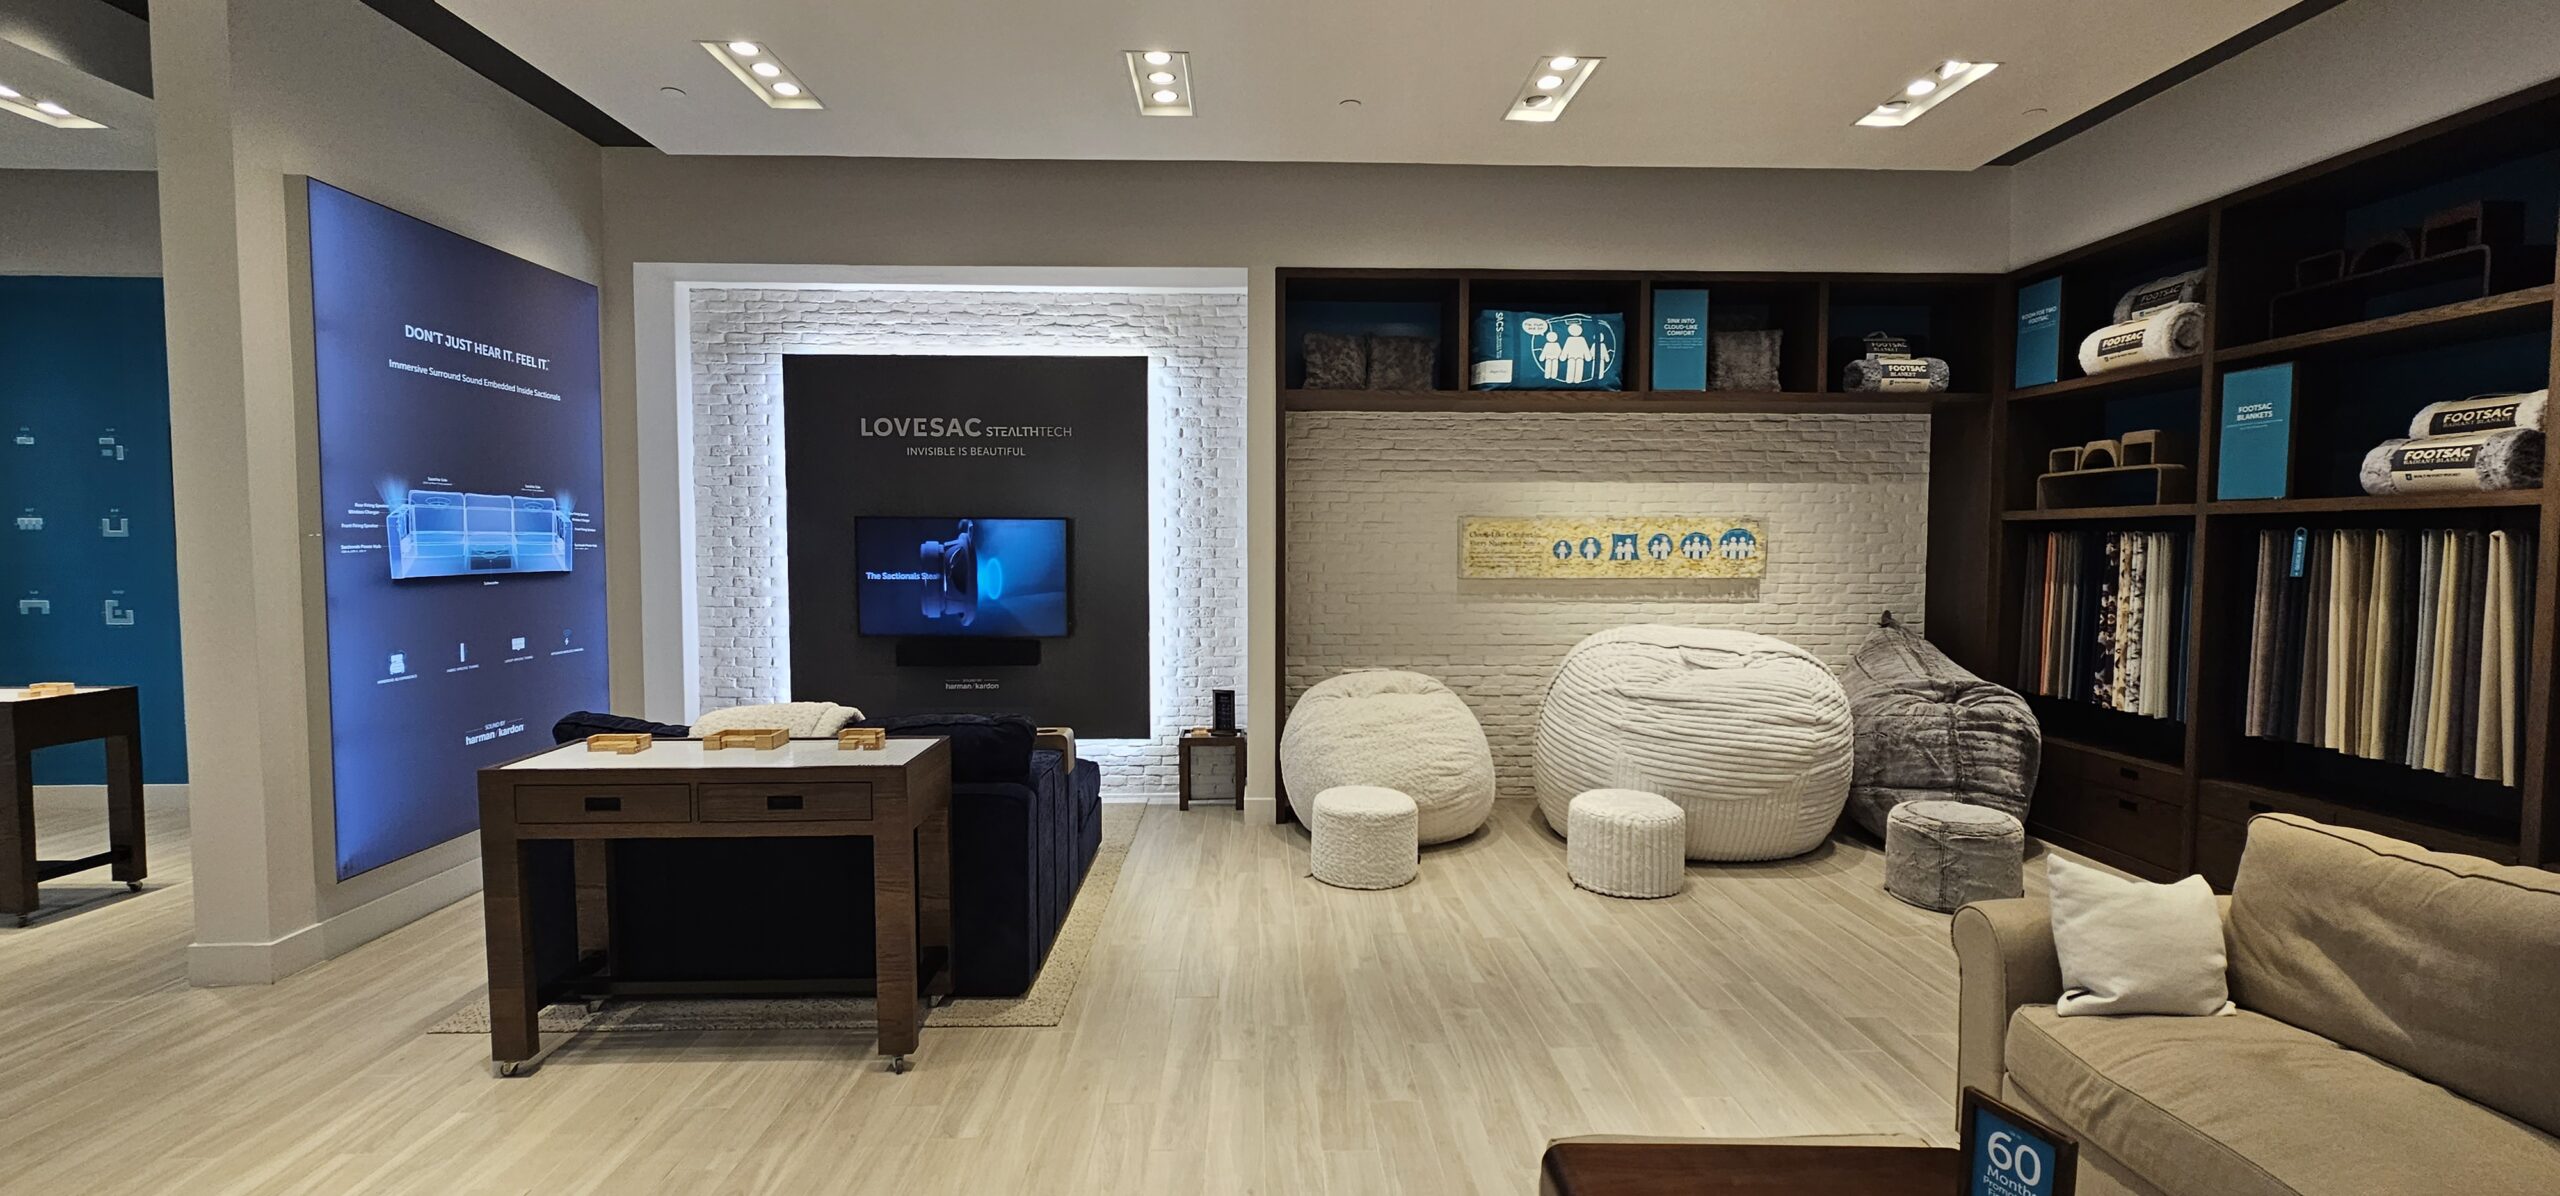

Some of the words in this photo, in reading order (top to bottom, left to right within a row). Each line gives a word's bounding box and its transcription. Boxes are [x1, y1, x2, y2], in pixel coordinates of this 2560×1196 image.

[405, 324, 443, 345] DON'T
[444, 335, 472, 352] JUST
[474, 342, 501, 360] HEAR
[503, 350, 514, 362] IT.
[516, 353, 537, 368] FEEL
[2102, 331, 2144, 348] FOOTSAC
[389, 359, 428, 375] Immersive
[429, 367, 461, 381] Surround
[462, 374, 483, 386] Sound
[484, 379, 516, 392] Embedded
[517, 386, 533, 396] Inside
[534, 389, 561, 401] Sactionals
[2236, 411, 2273, 421] BLANKETS
[2238, 403, 2272, 413] FOOTSAC
[2444, 406, 2514, 423] FOOTSAC
[861, 418, 982, 437] LOVESAC
[986, 426, 1072, 437] STEALTHTECH
[907, 447, 956, 456] INVISIBLE
[958, 447, 968, 456] IS
[970, 447, 1026, 456] BEAUTIFUL
[2404, 447, 2473, 461] FOOTSAC
[882, 572, 920, 580] Sactionals
[1988, 1131, 2041, 1186] 60
